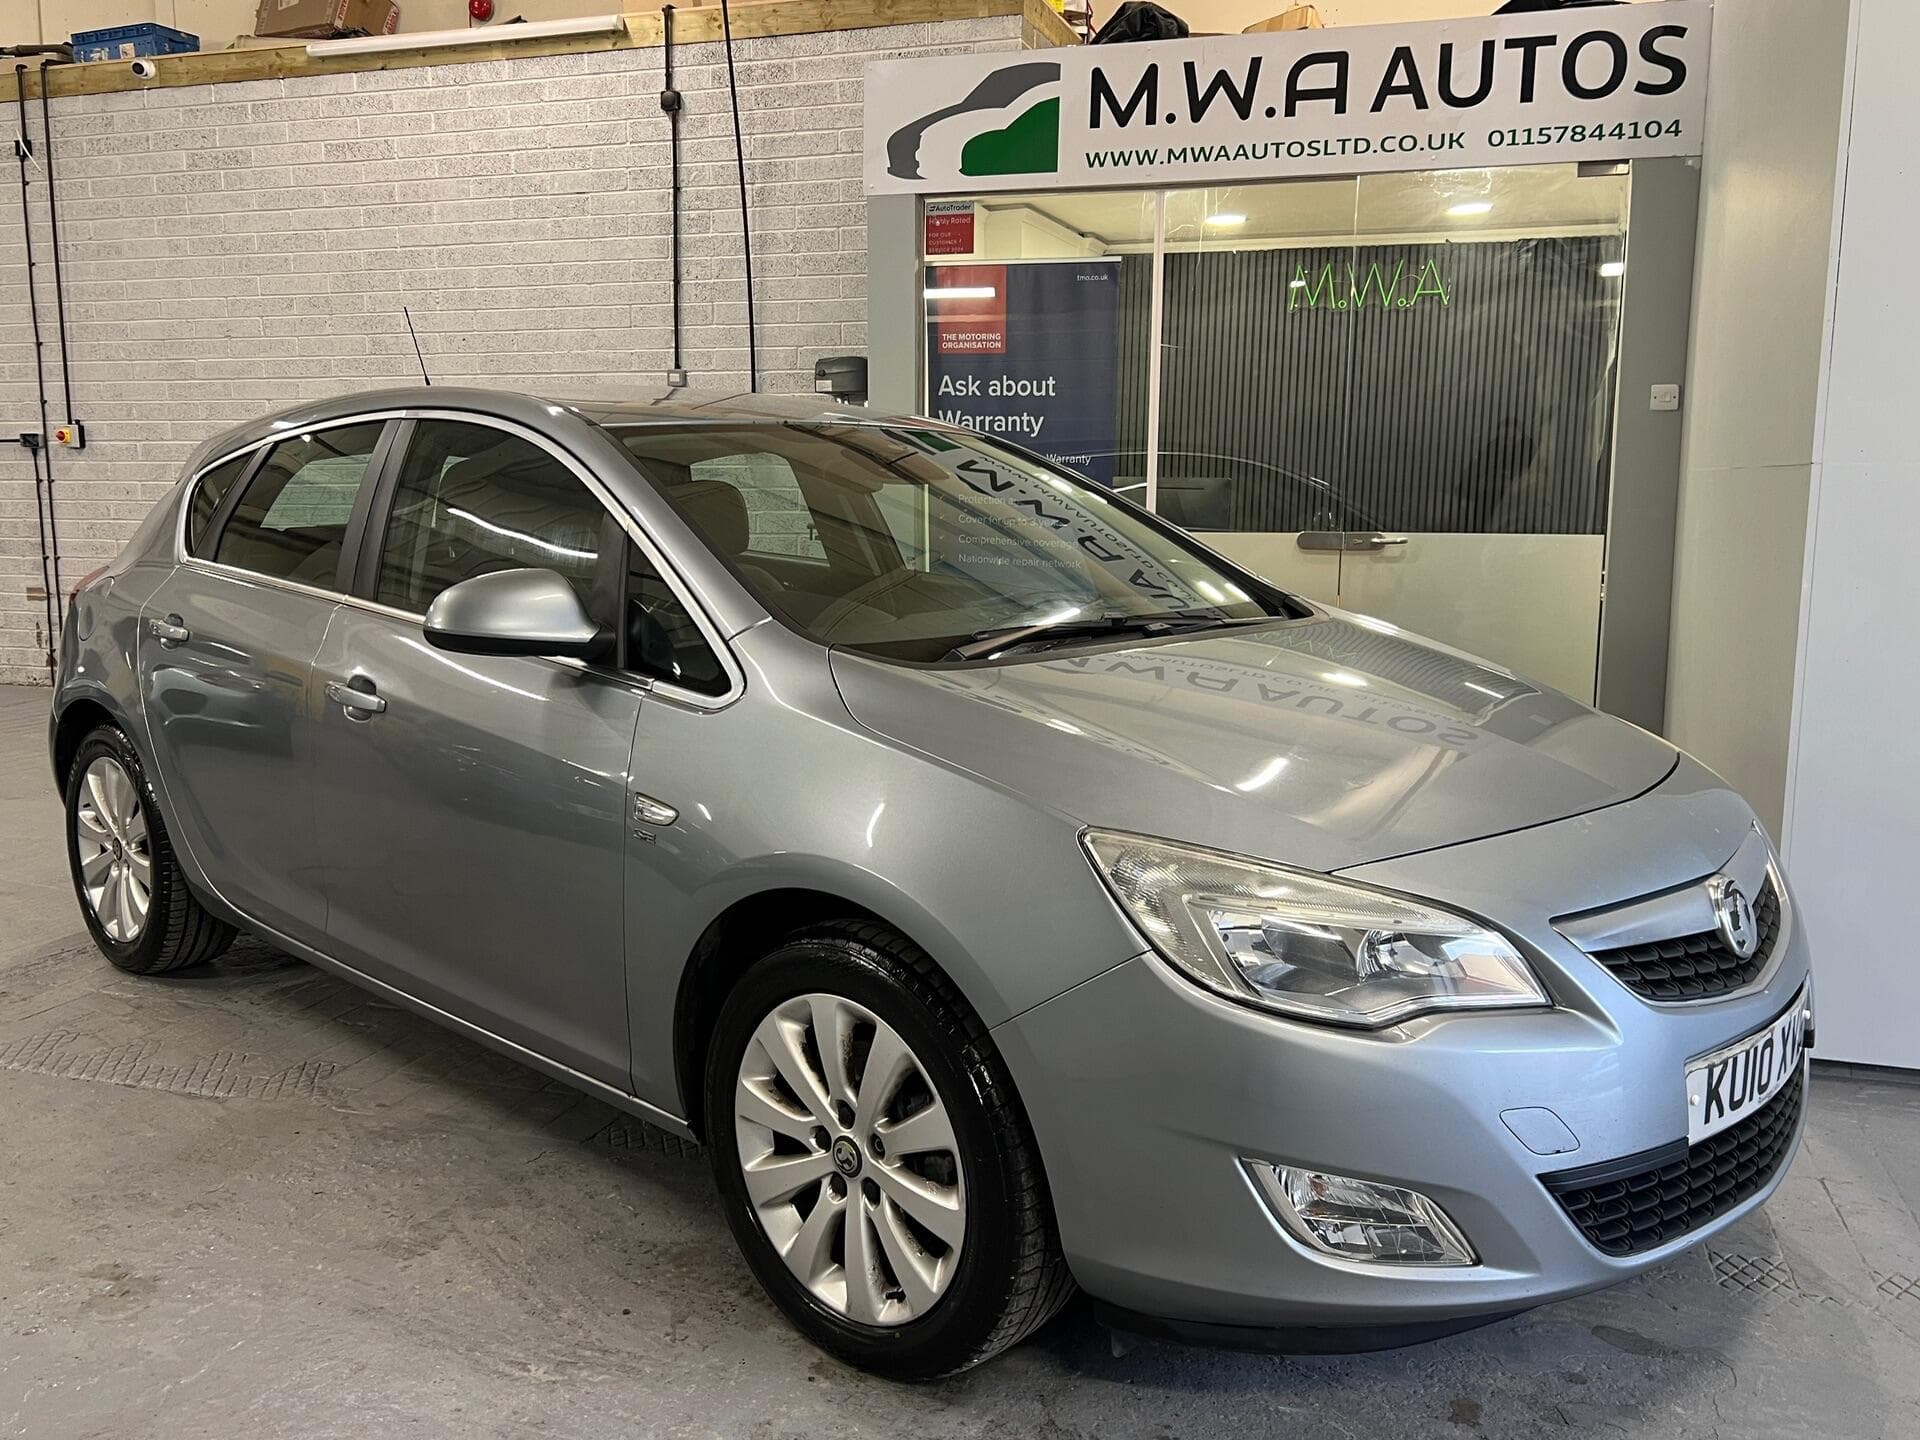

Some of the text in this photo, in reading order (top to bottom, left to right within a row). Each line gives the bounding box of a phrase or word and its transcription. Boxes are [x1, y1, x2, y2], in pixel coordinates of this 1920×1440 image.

[1089, 25, 1688, 129] M.W.A AUTOS
[1085, 119, 1683, 169] WWW.MWAAUTOSLTD.CO.UK 01157844104
[1290, 259, 1448, 310] M.W.A
[942, 333, 1001, 341] THE MOTORING
[942, 341, 1002, 349] ORGANISATION
[938, 375, 1056, 396] Ask about
[938, 409, 1044, 437] Warranty
[1047, 453, 1092, 466] Warranty
[958, 494, 1005, 504] Protection
[958, 514, 982, 524] Cover
[1004, 517, 1016, 528] up
[1019, 516, 1029, 526] to
[958, 534, 1031, 546] Comprehensive
[958, 554, 1009, 566] Nationwide
[1012, 557, 1041, 570] repair
[1704, 1037, 1774, 1125] KU10
